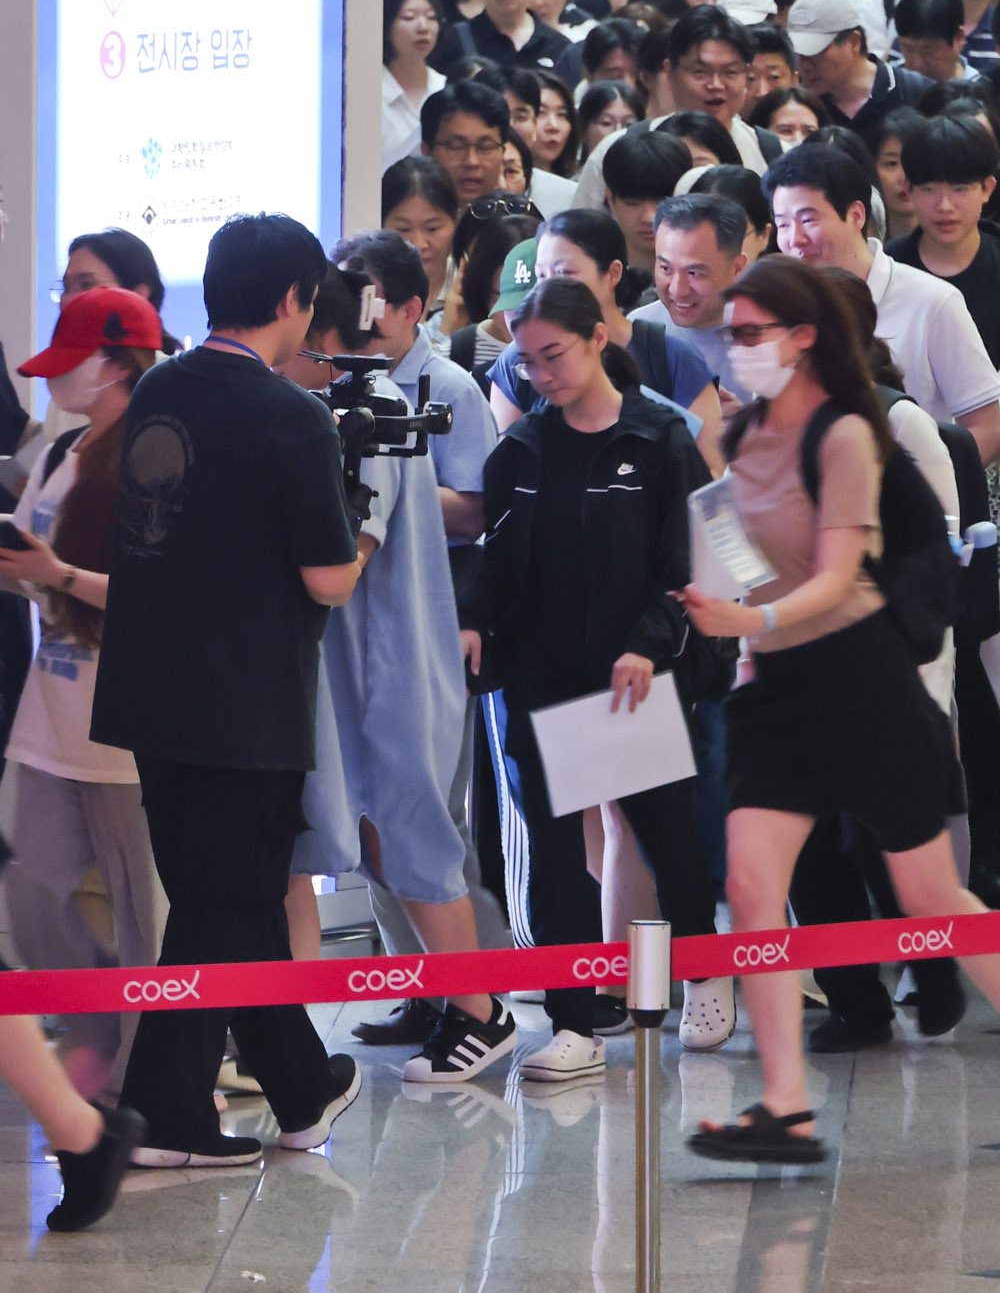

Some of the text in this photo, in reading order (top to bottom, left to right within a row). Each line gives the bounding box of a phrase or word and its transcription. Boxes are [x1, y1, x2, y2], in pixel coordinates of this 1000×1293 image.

[137, 32, 201, 73] 전시장
[211, 29, 252, 69] 입장
[514, 259, 532, 284] LA
[123, 970, 200, 1003] coex
[348, 959, 424, 993] coex
[573, 956, 628, 979] coe
[733, 935, 790, 967] coex
[898, 921, 954, 954] coex
